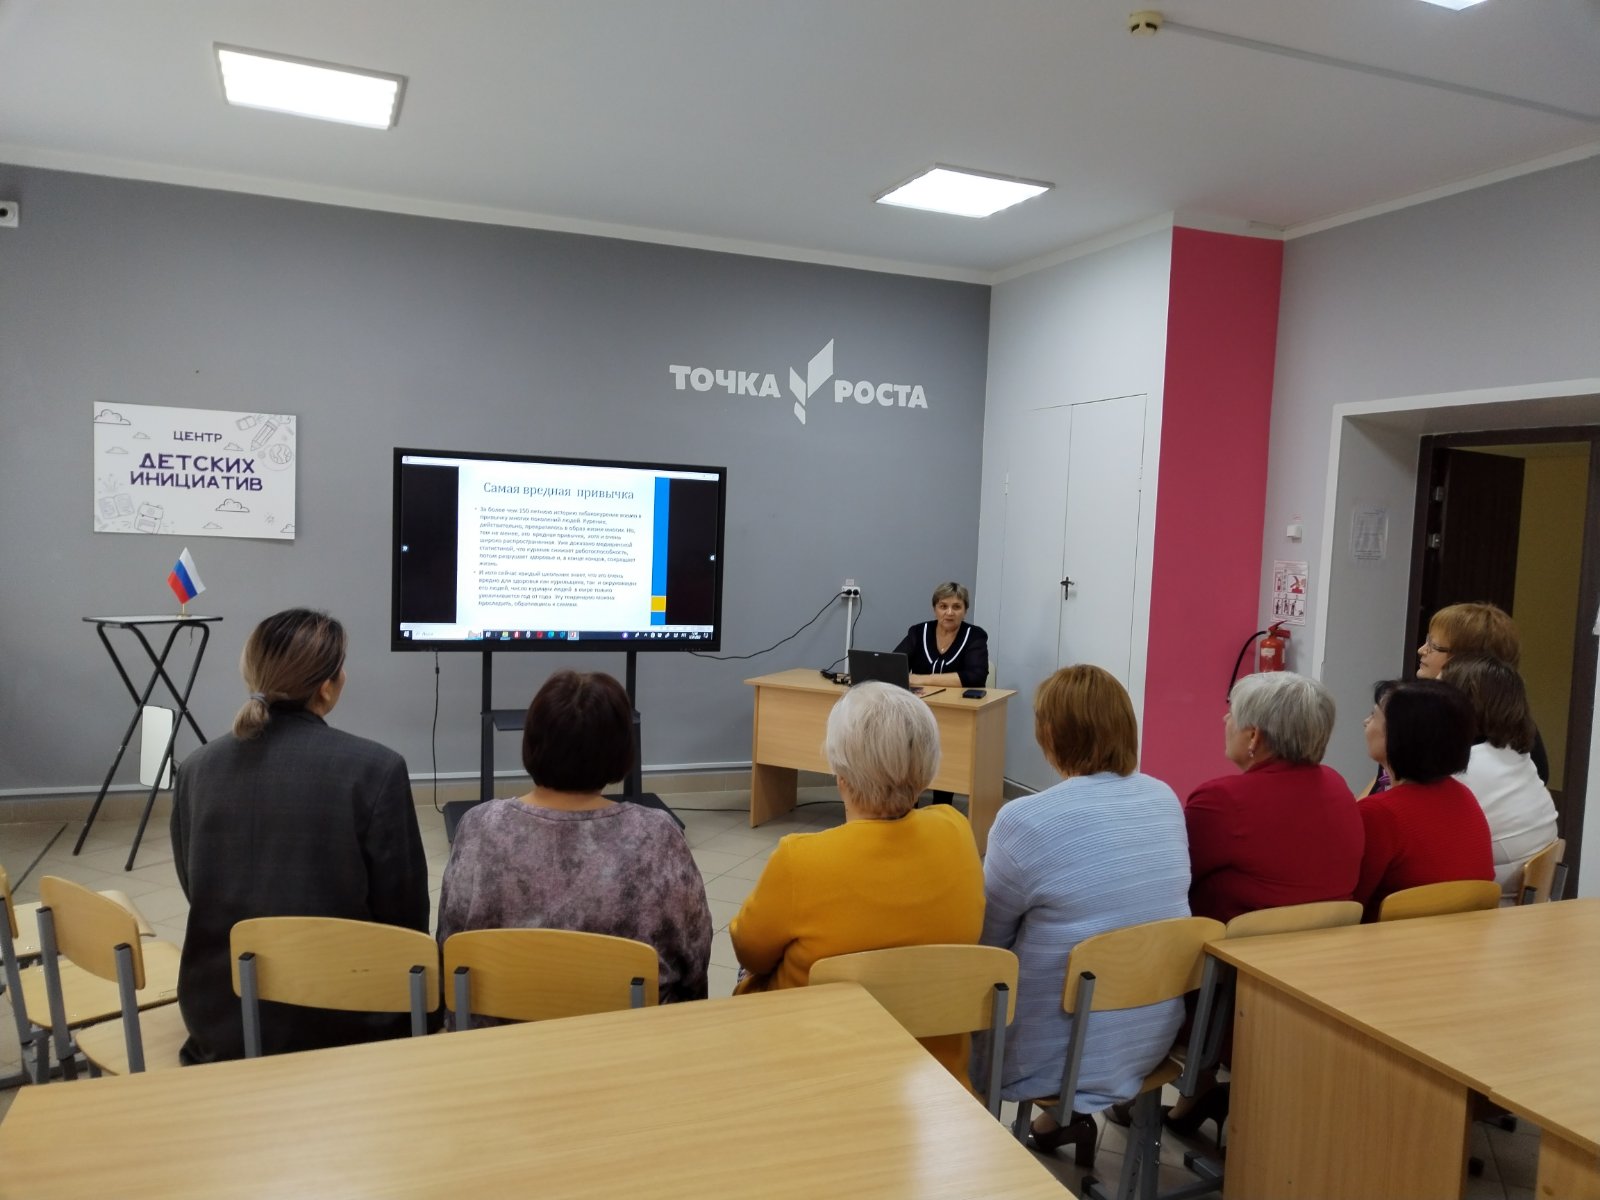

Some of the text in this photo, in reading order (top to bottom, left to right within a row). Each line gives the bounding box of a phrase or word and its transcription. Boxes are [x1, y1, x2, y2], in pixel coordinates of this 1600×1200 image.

[669, 364, 928, 408] ТОЧКА РОСТА
[173, 430, 223, 442] ЦЕНТР
[139, 453, 255, 473] ДЕТСКИХ
[130, 471, 263, 491] ИНИЦИАТИВ
[483, 482, 634, 500] Самая вредная привычка
